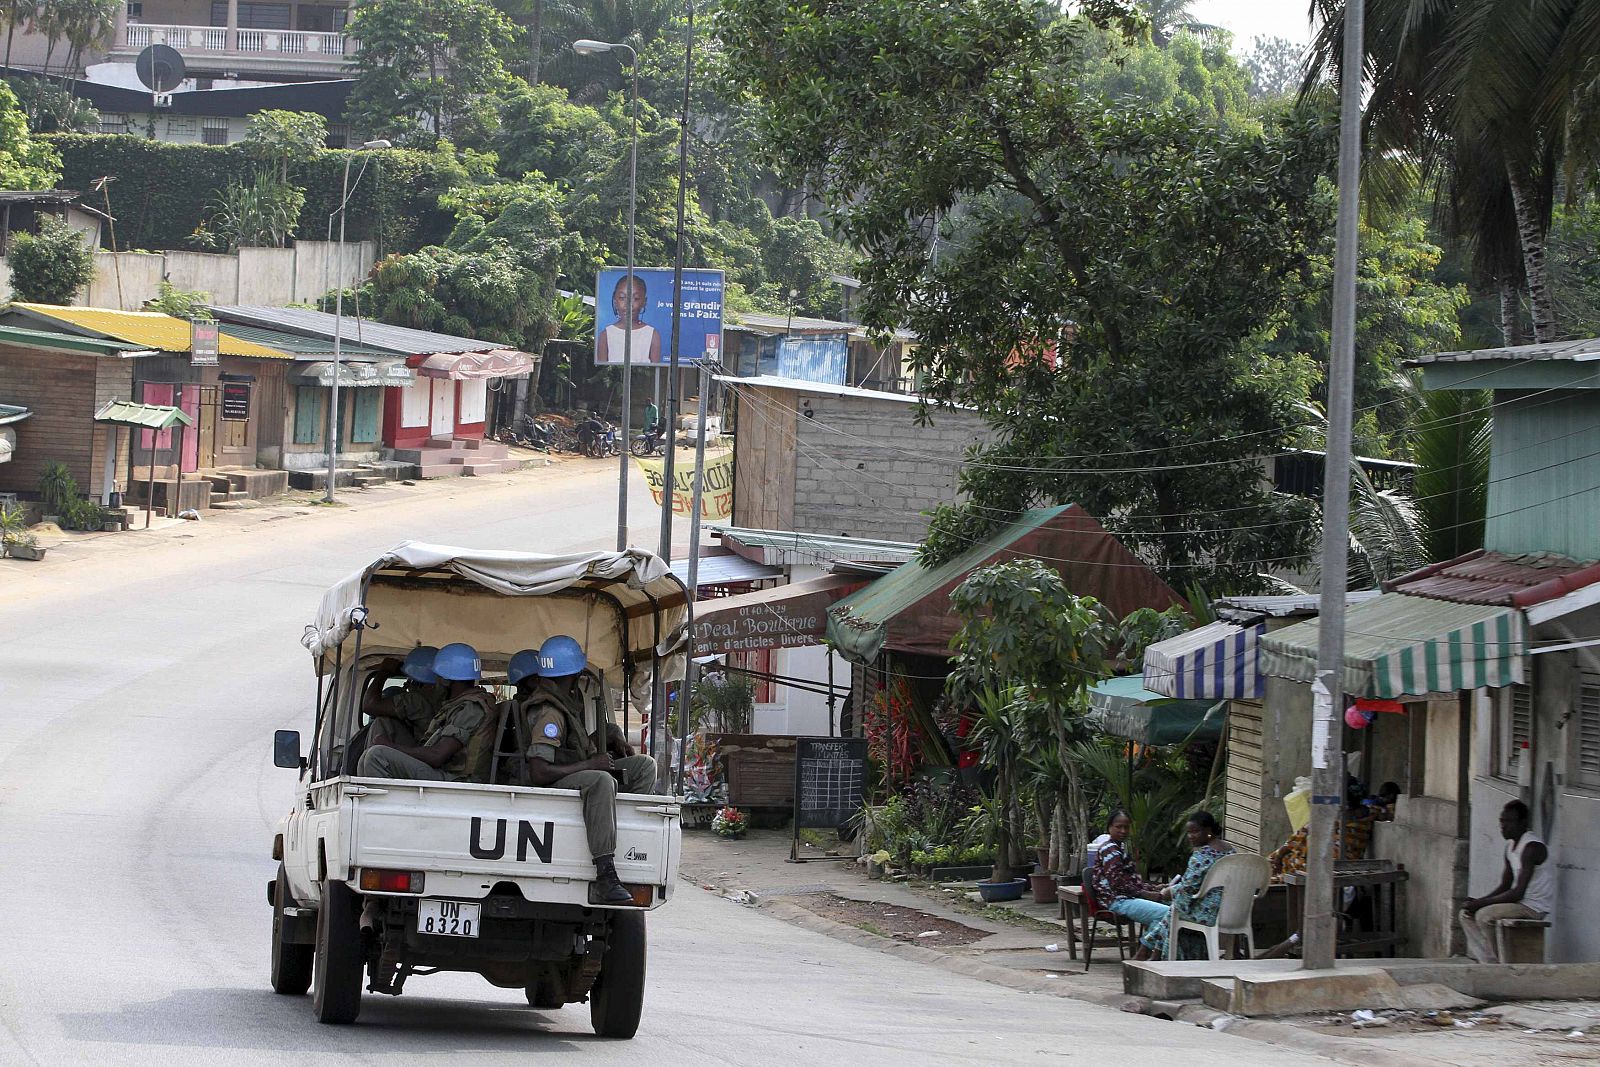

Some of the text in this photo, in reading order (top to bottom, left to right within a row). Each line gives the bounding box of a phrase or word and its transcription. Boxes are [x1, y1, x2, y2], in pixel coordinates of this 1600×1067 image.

[657, 300, 664, 308] je
[683, 301, 721, 310] grandir
[696, 310, 721, 319] Paix.
[694, 641, 719, 654] ente
[724, 636, 775, 650] d'articles
[540, 657, 554, 669] UN
[469, 816, 554, 864] UN
[440, 902, 460, 919] UN
[425, 916, 472, 936] 8320
